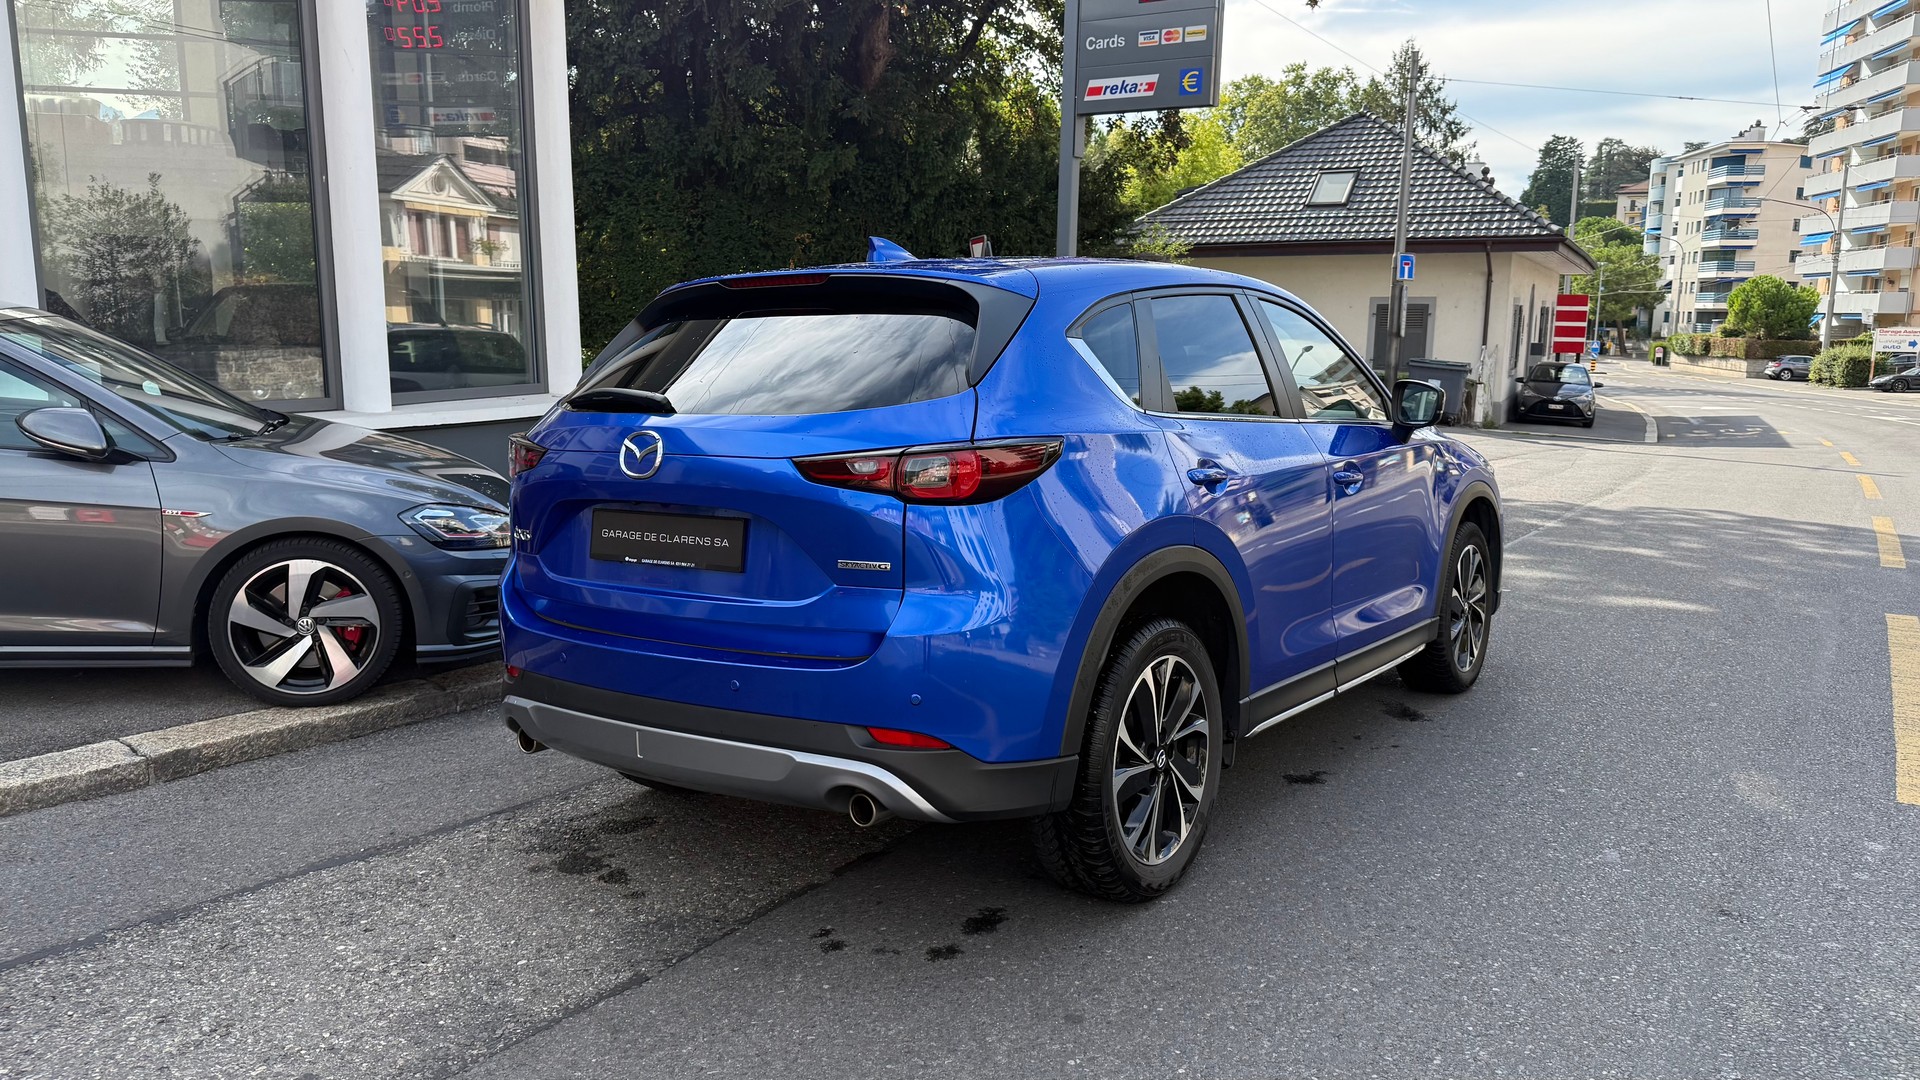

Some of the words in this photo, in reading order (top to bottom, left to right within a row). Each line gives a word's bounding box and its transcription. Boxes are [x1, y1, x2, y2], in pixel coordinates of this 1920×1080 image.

[1085, 34, 1126, 50] Cards
[601, 528, 642, 541] GARAGE
[643, 532, 657, 542] DE
[659, 533, 711, 546] CLARENS
[713, 538, 730, 547] SA
